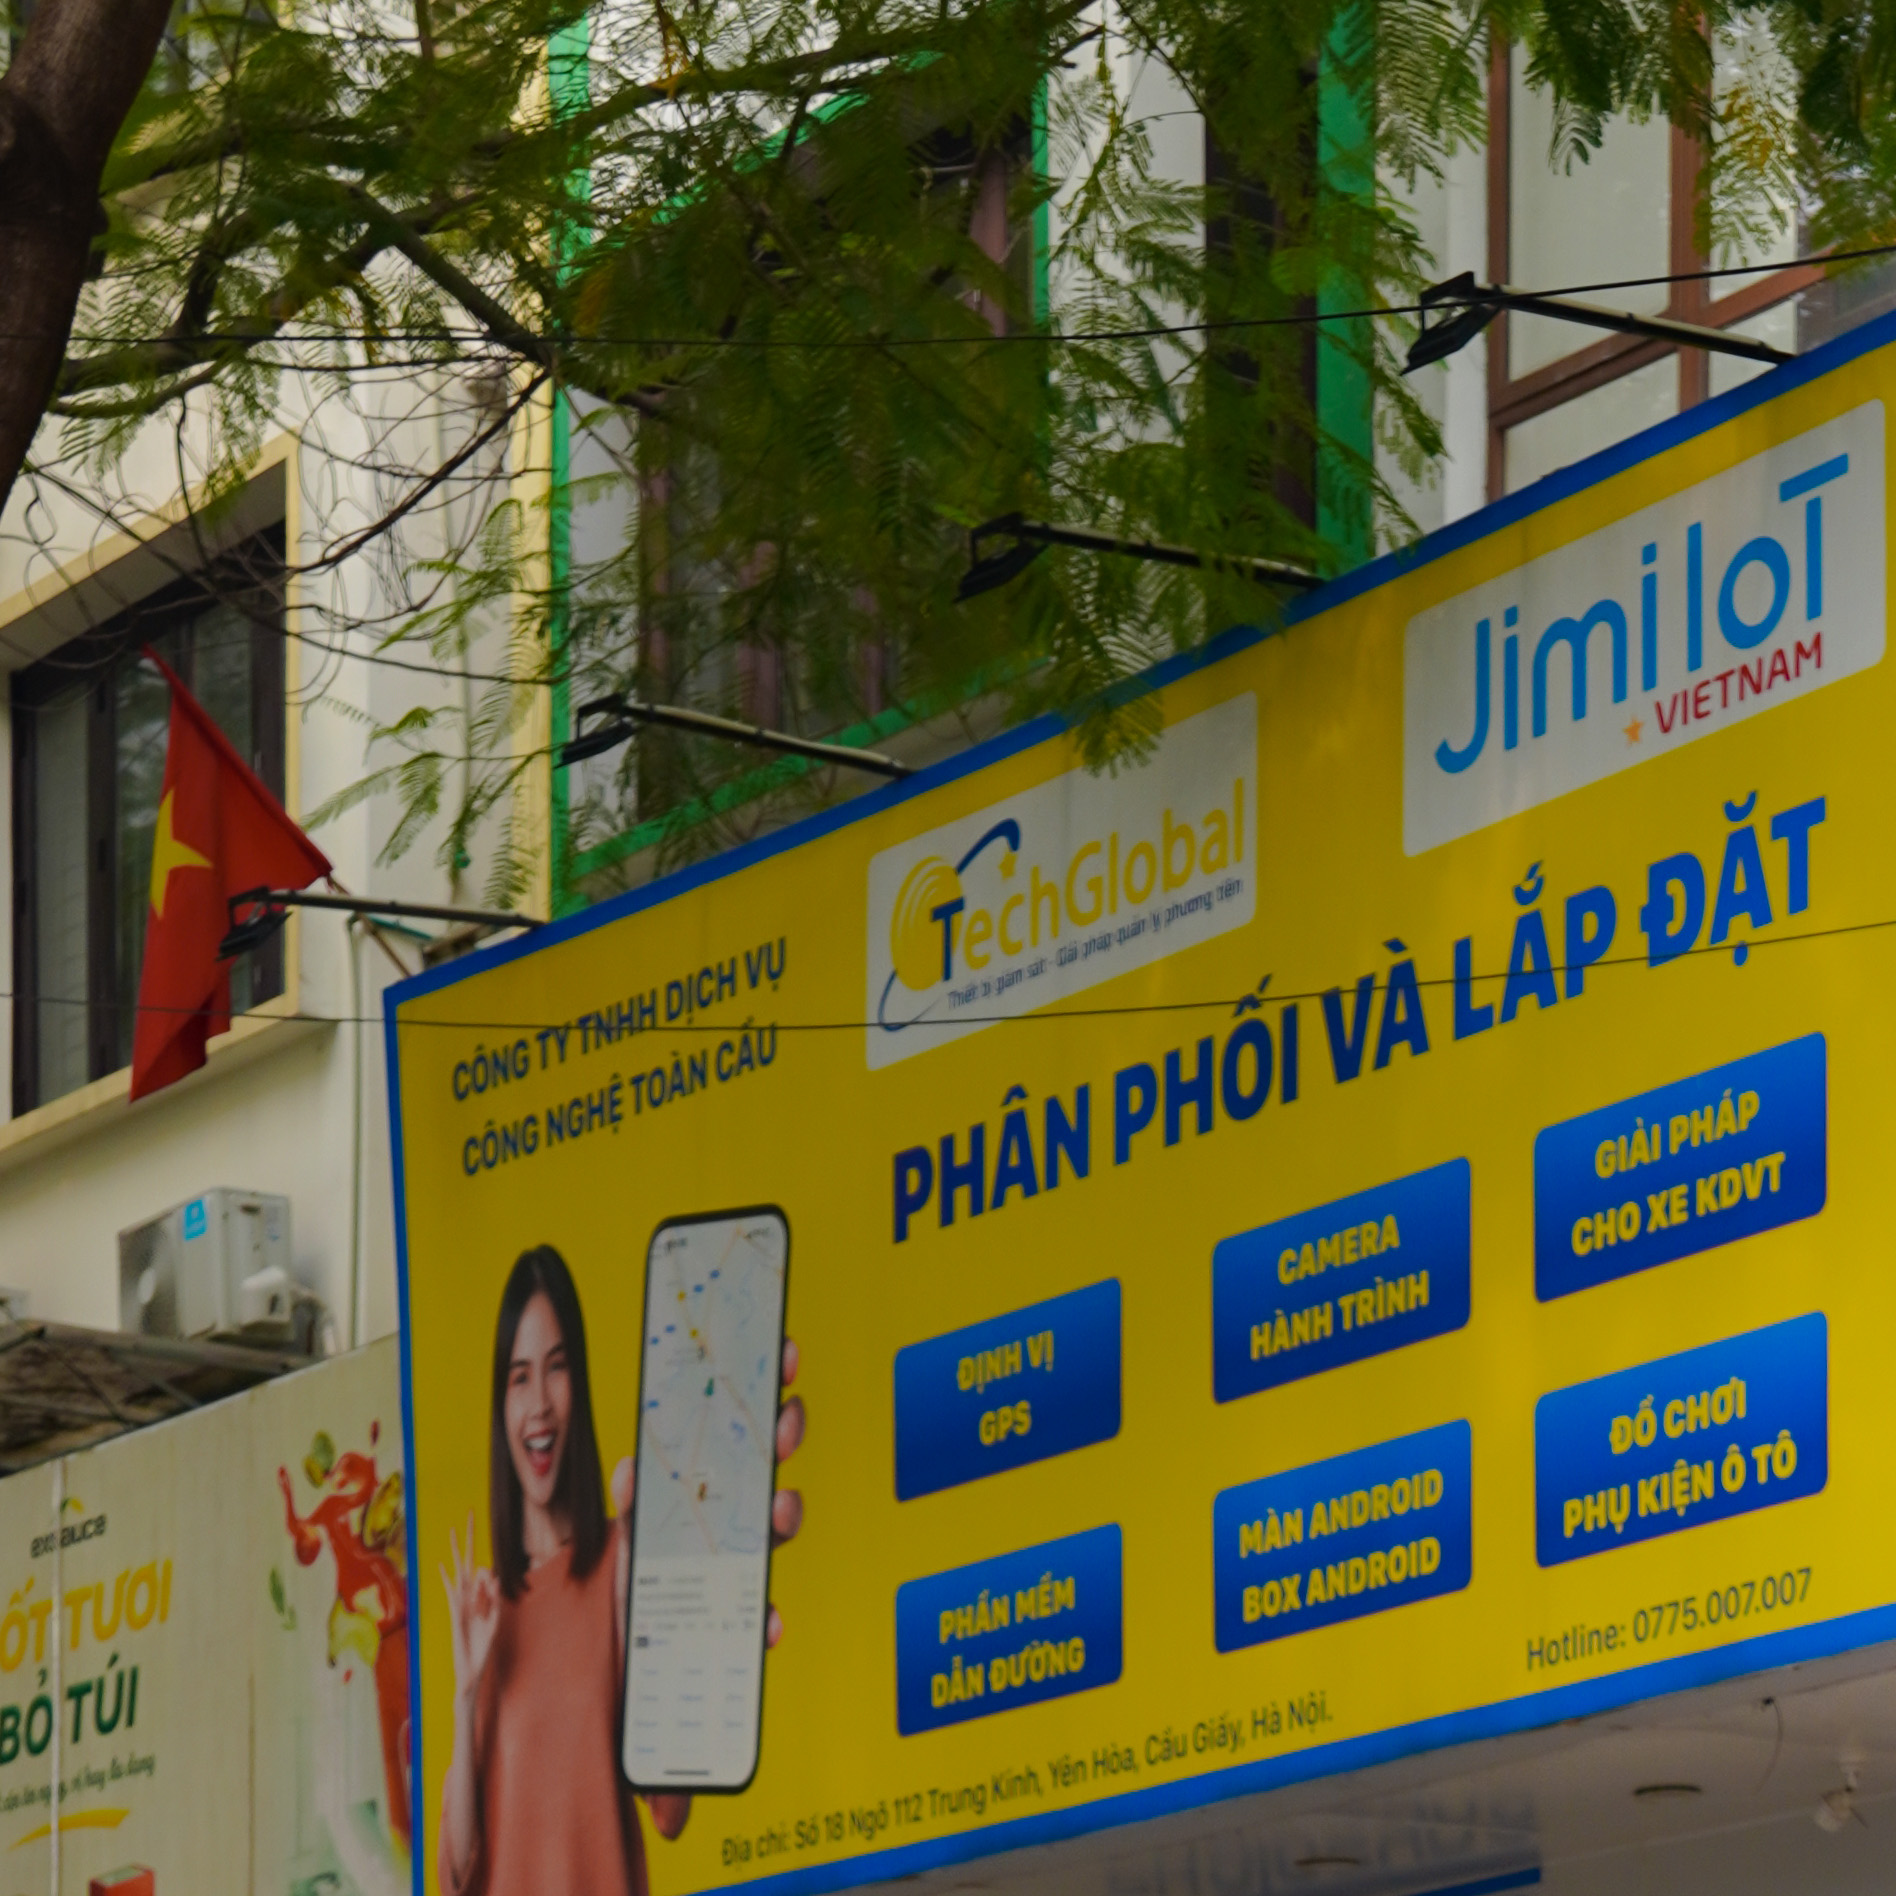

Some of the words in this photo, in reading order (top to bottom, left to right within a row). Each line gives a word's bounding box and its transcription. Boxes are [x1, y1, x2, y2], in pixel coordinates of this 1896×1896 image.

[1654, 630, 1825, 735] VIETNAM
[930, 776, 1245, 983] TechGlobal
[453, 1044, 530, 1101] CÔNG
[536, 1021, 573, 1071] TY
[577, 988, 657, 1055] TNHH
[665, 956, 737, 1026] DỊCH
[745, 936, 786, 993] VỤ
[893, 1083, 1091, 1245] PHÂN
[1113, 973, 1300, 1167] PHỐI
[1319, 937, 1430, 1086] VÀ
[1452, 860, 1616, 1041] LẮP
[1639, 790, 1828, 969] ĐẶT
[463, 1119, 539, 1176] CÔNG
[546, 1072, 623, 1134] NGHỆ
[630, 1050, 708, 1115] TOÀN
[1594, 1117, 1662, 1179] GIẢI
[1669, 1087, 1760, 1155] PHÁP
[1278, 1214, 1400, 1286] CAMERA
[1570, 1202, 1642, 1257] CHO
[1645, 1183, 1689, 1235] XE
[1694, 1151, 1786, 1216] KDVT
[956, 1340, 1022, 1394] ĐỊNH
[1026, 1330, 1055, 1371] VỊ
[1250, 1301, 1333, 1362] HÀNH
[1338, 1270, 1430, 1330] TRÌNH
[979, 1400, 1032, 1446] GPS
[1609, 1394, 1658, 1455] ĐỒ
[1664, 1376, 1747, 1438] CHƠI
[1238, 1508, 1303, 1559] MÀN
[1309, 1468, 1443, 1539] ANDROID
[1563, 1483, 1630, 1538] PHỤ
[1637, 1458, 1715, 1517] KIỆN
[1721, 1444, 1747, 1494] Ô
[1751, 1429, 1798, 1485] TÔ
[1242, 1573, 1301, 1624] BOX
[1306, 1536, 1441, 1605] ANDROID
[1527, 1623, 1626, 1672] Hotline:
[1632, 1567, 1813, 1644] 0775.007.007
[67, 1650, 139, 1745] TÚI
